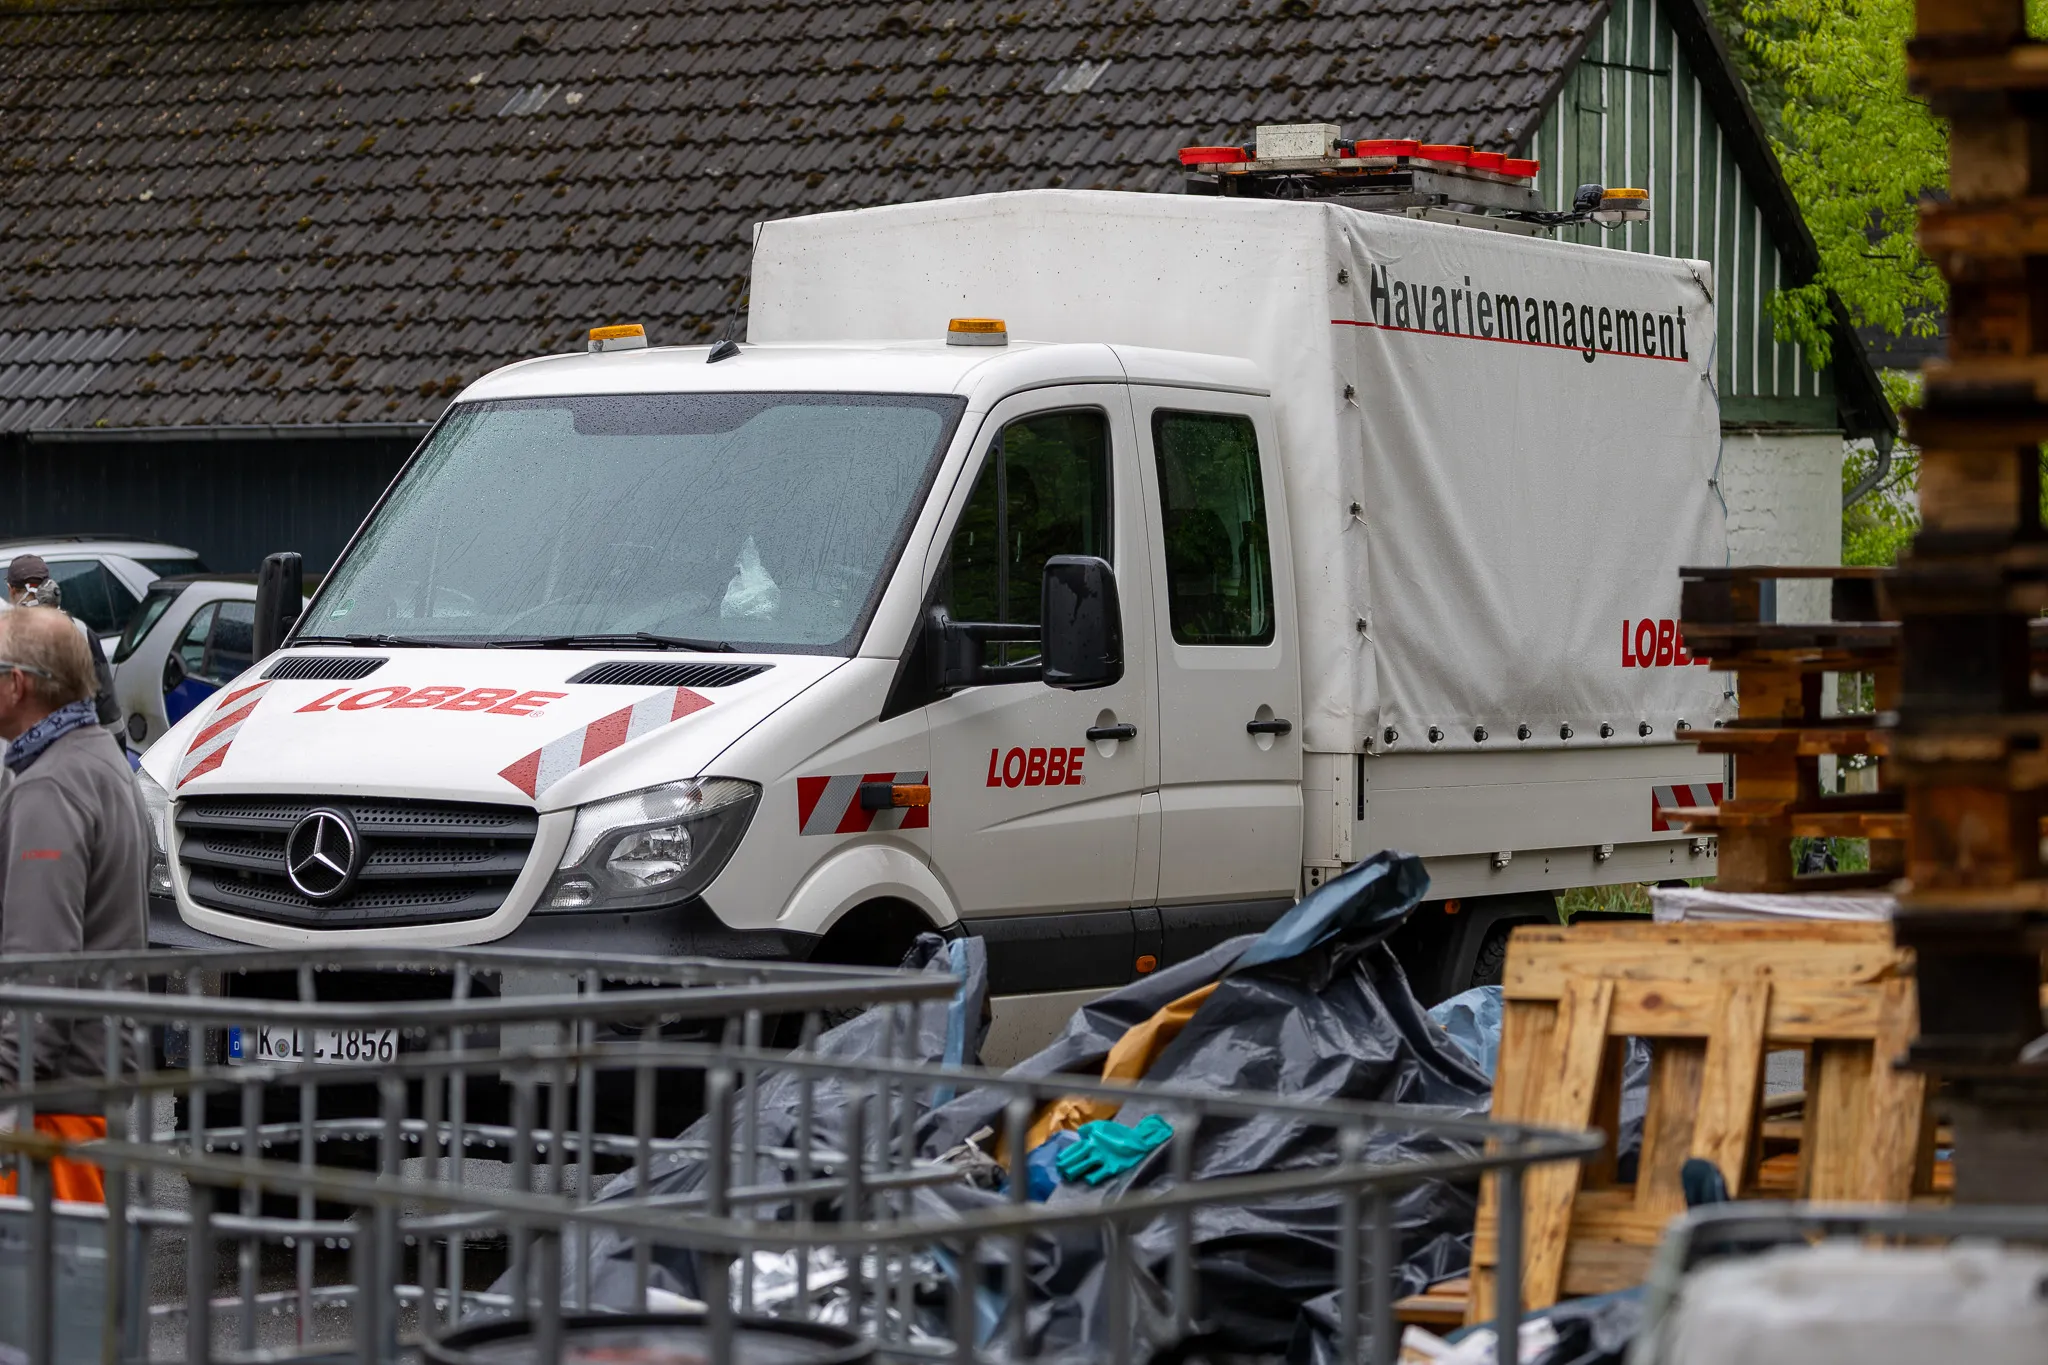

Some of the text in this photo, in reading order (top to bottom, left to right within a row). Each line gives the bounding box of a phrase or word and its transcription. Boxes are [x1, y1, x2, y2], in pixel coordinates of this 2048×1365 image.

[1370, 263, 1689, 363] Havariemanagement
[1621, 617, 1710, 669] LOBB
[293, 686, 569, 717] LOBBE
[986, 746, 1086, 789] LOBBE
[259, 1024, 273, 1056] K
[330, 1027, 393, 1063] 1856
